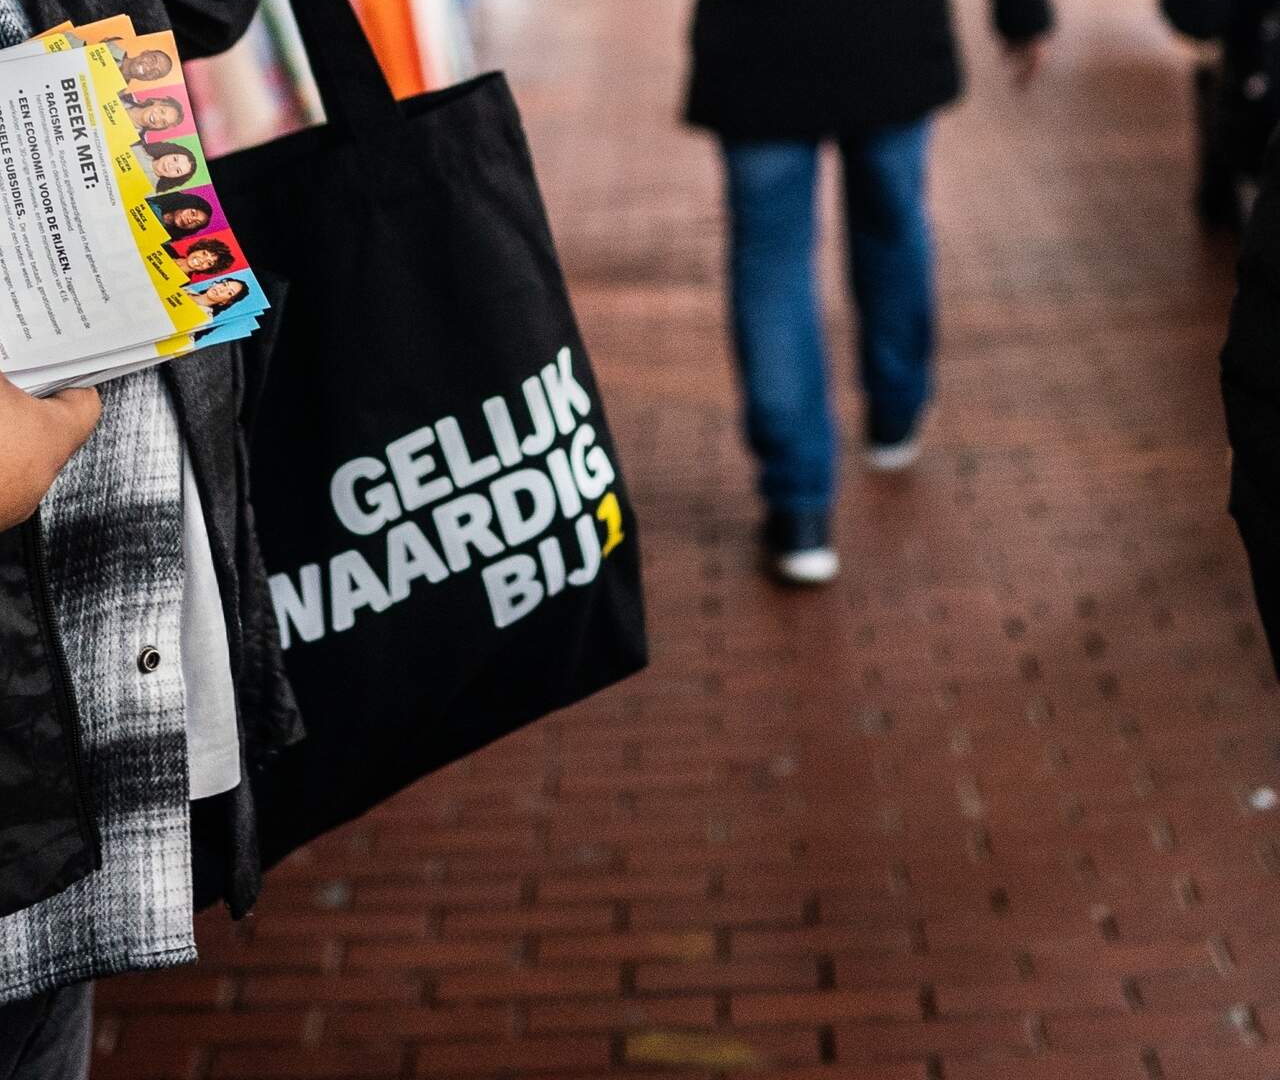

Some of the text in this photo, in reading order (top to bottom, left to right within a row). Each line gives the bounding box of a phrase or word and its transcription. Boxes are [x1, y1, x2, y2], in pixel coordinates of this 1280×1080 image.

[17, 96, 31, 119] EEN
[44, 91, 66, 145] RACISME.
[59, 77, 101, 189] BREEK MET:
[23, 121, 46, 181] ECONOMIE
[3, 156, 27, 219] SUBSIDIES.
[37, 182, 54, 214] VOOR
[46, 216, 58, 231] DE
[50, 233, 72, 274] RIJKEN.
[329, 345, 592, 536] GELIJK
[481, 492, 625, 629] BIJ1
